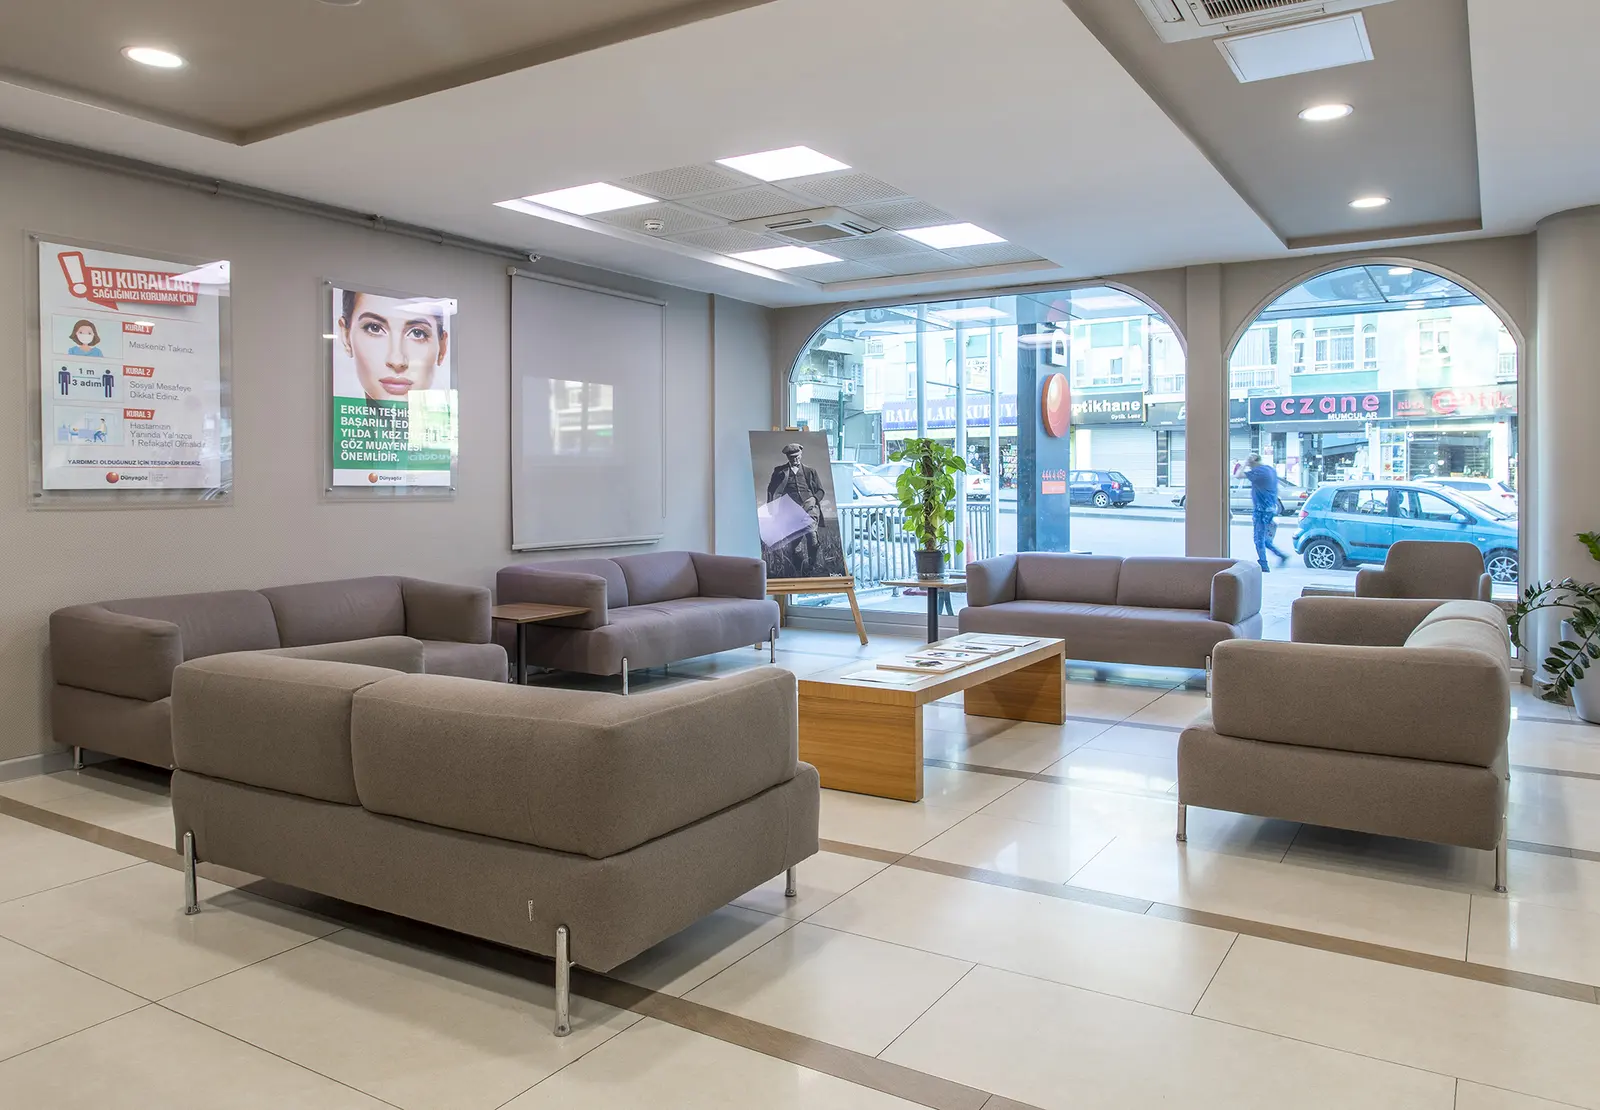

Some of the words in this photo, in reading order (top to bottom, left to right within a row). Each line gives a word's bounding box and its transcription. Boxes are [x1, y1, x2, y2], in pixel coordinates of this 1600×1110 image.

[90, 270, 113, 288] BU
[116, 272, 194, 292] KURALLAR
[92, 288, 140, 300] SAĞLIĞINIZI
[140, 291, 178, 302] KORUMAK
[180, 292, 194, 304] İÇİN
[125, 323, 145, 332] KURAL
[128, 341, 166, 352] Maskenizi
[126, 366, 146, 376] KURAL
[146, 368, 151, 376] 2
[80, 379, 102, 387] adım
[130, 381, 154, 391] Sosyal
[156, 382, 192, 392] Mesafeye
[130, 391, 154, 400] Dikkat
[1071, 400, 1140, 416] ptikhane
[1260, 394, 1380, 415] eczane
[126, 410, 146, 418] KURAL
[340, 405, 376, 416] ERKEN
[1328, 412, 1378, 420] MUMCULAR
[340, 416, 388, 428] BAŞARILI
[130, 430, 160, 438] Yanında
[340, 428, 371, 438] YILDA
[374, 430, 378, 438] 1
[382, 431, 402, 440] KEZ
[340, 438, 363, 450] GÖZ
[340, 450, 400, 462] ÖNEMLİDİR.
[120, 474, 148, 482] Dünyagöz
